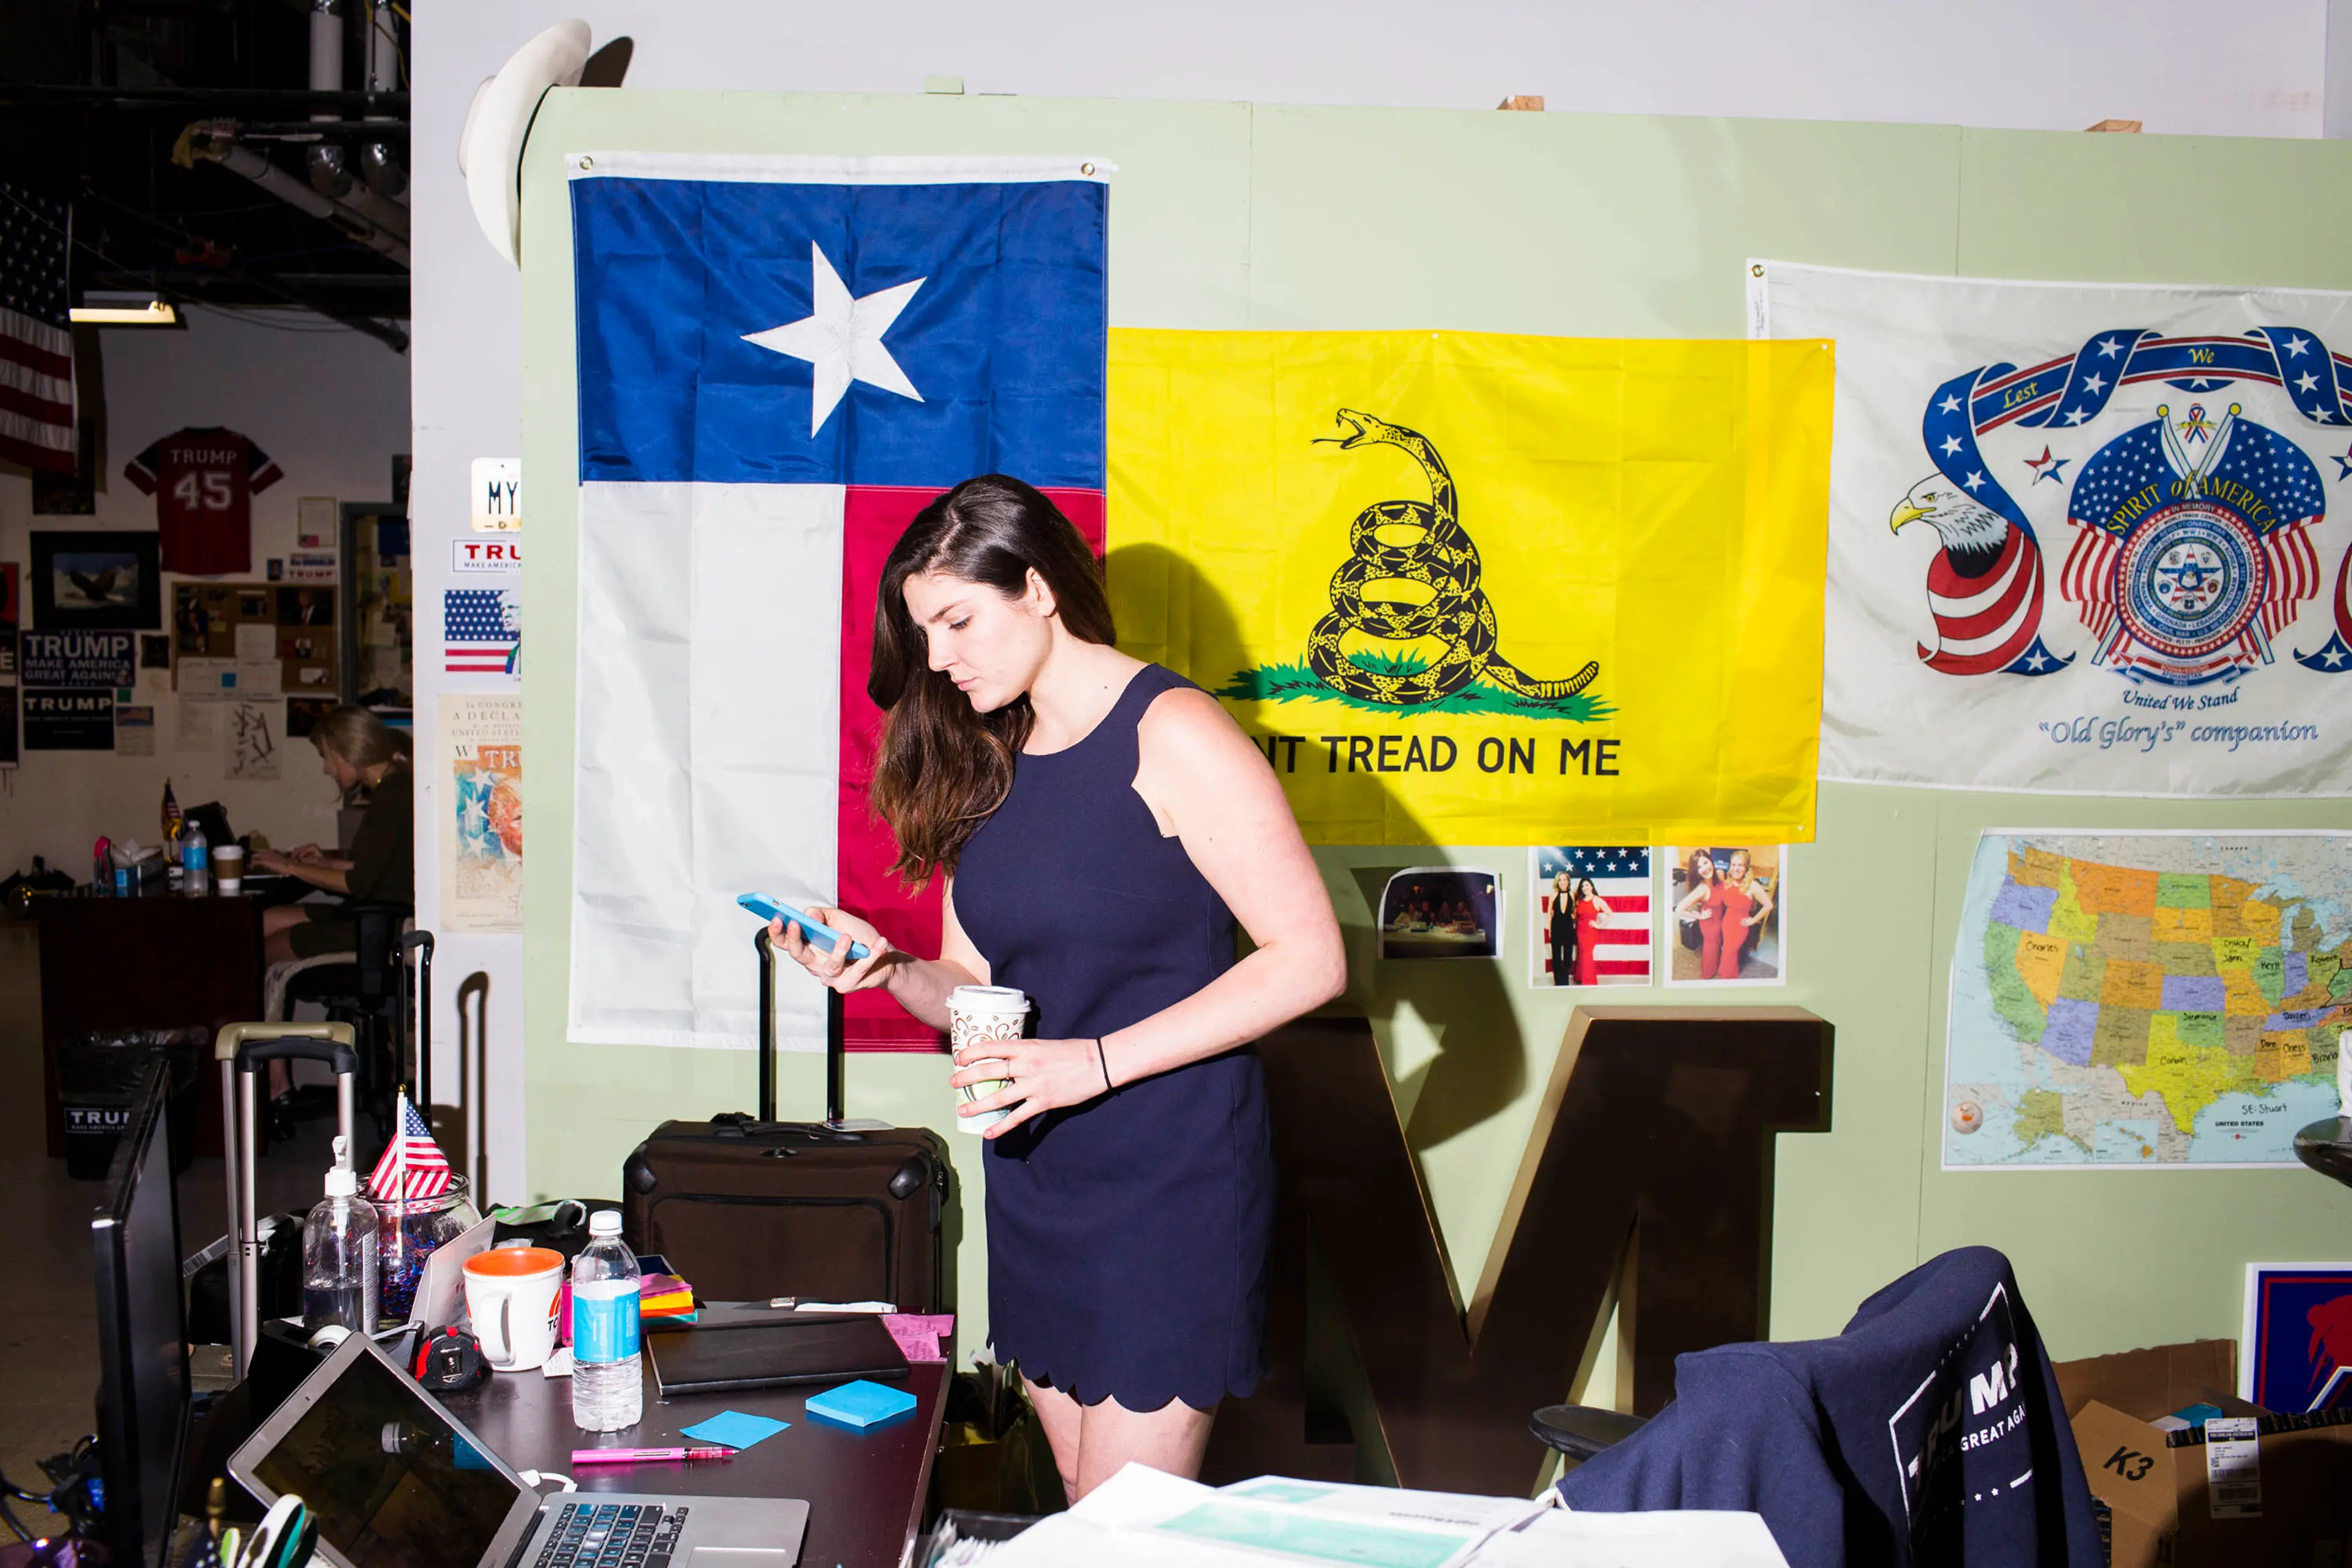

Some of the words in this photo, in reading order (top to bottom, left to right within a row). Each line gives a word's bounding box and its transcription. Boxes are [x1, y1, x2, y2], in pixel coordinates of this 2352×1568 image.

[2188, 347, 2214, 365] We
[2002, 382, 2038, 409] Lest
[169, 447, 238, 466] TRUMP
[172, 470, 234, 511] 45
[489, 481, 518, 514] MY
[2106, 484, 2162, 534] SPIRIT
[2171, 469, 2199, 499] of
[2199, 477, 2277, 532] AMERICA
[26, 635, 130, 659] TRUMP
[25, 658, 64, 669] MAKE
[69, 659, 132, 669] AMERICA
[25, 671, 66, 681] GREAT
[24, 696, 112, 711] TRUMP
[2123, 688, 2171, 710] United
[2173, 695, 2195, 711] We
[2197, 685, 2241, 710] Stand
[2190, 720, 2320, 752] companion
[1321, 736, 1457, 772] TREAD
[1477, 737, 1535, 774] ON
[1559, 739, 1621, 775] ME
[2259, 1103, 2287, 1114] Stuart
[1960, 1420, 2004, 1452] GREAT
[2103, 1446, 2155, 1482] K3
